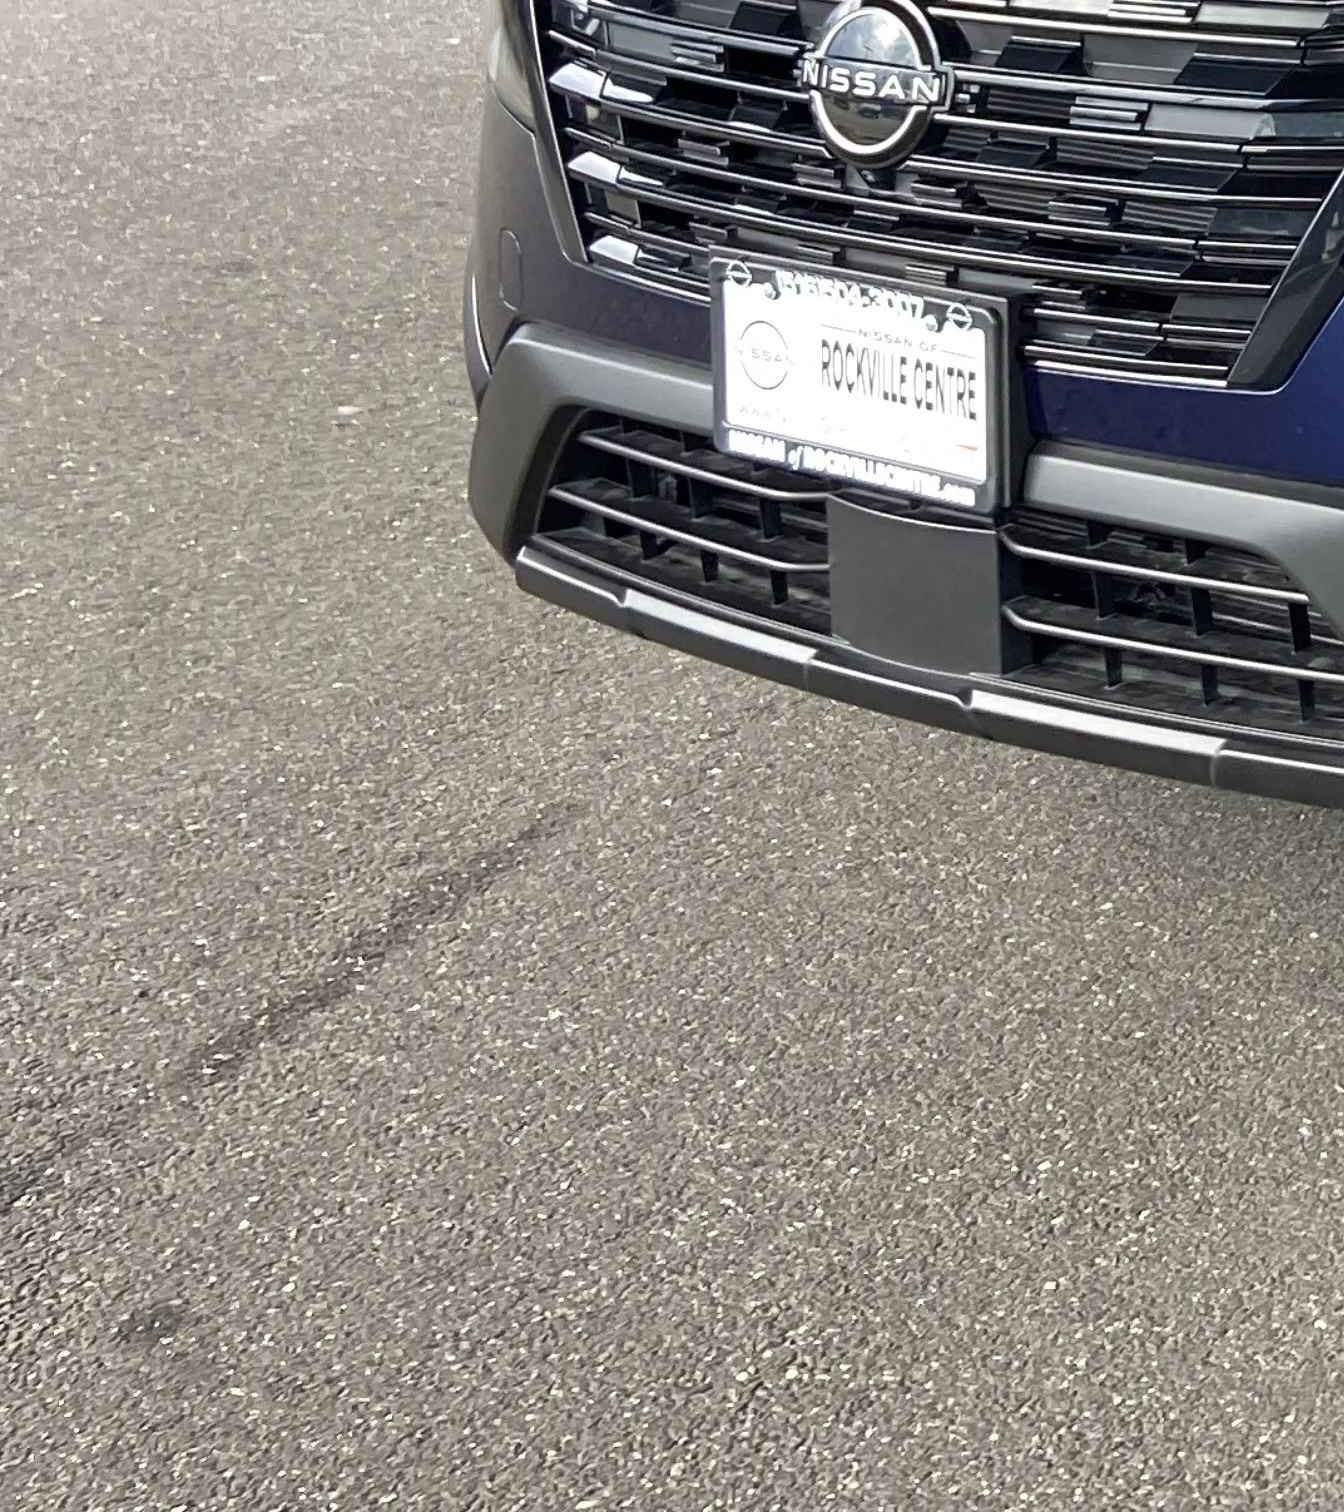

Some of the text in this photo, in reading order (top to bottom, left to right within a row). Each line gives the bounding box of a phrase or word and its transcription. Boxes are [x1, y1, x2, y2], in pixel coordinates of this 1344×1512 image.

[803, 58, 940, 101] NISSAN
[858, 327, 938, 352] NISSAN OF
[821, 338, 977, 421] ROCKVILLE CENTRE
